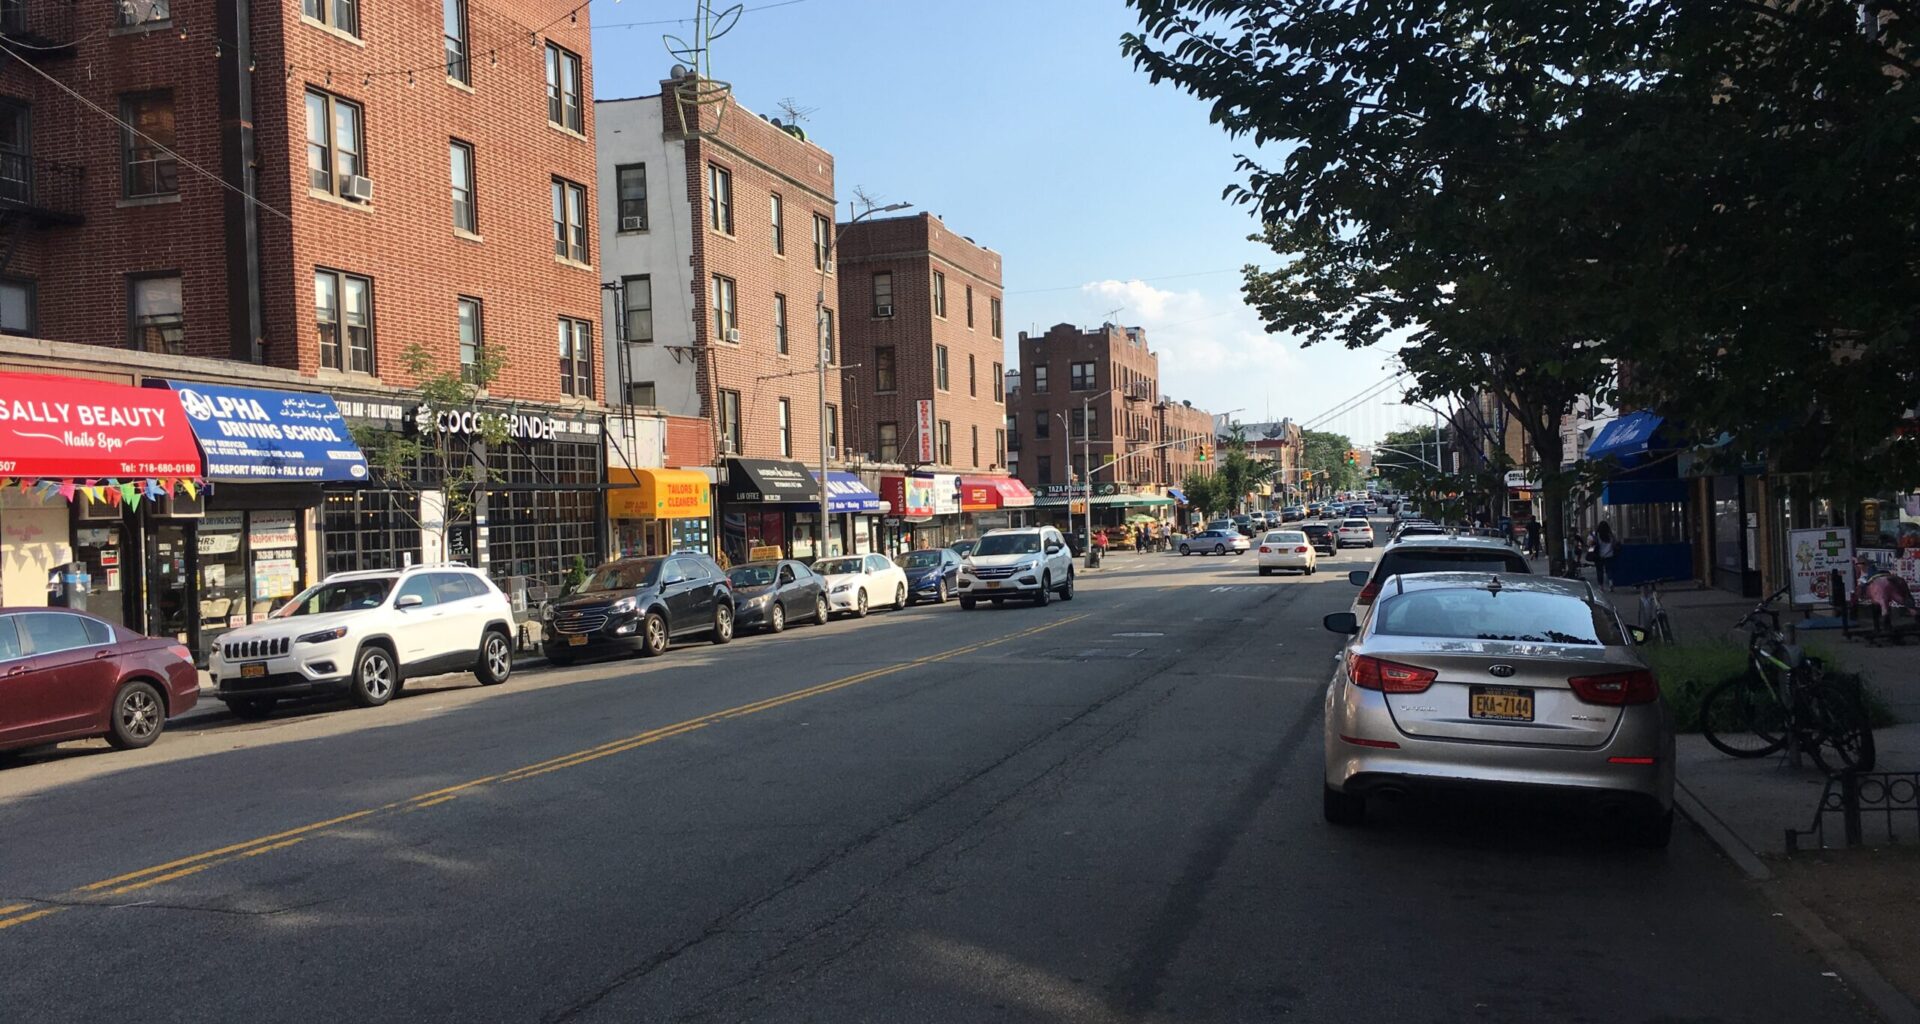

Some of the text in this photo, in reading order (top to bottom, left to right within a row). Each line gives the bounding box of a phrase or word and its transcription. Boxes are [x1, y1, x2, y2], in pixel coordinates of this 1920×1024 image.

[179, 389, 271, 421] ALPHA
[367, 403, 380, 418] FULL
[0, 399, 166, 428] SALLY BEAUTY
[437, 409, 497, 436] COCO
[217, 420, 342, 443] DRIVING SCHOOL
[64, 431, 123, 453] Nails Spa
[121, 462, 137, 473] Tel:
[139, 463, 196, 473] 718-680-0180
[210, 464, 324, 477] PASSPORT PHOTO FAX & COPY
[667, 484, 693, 495] TAILORS
[746, 491, 760, 500] OFFICE
[668, 497, 698, 508] CLEANERS
[1493, 666, 1512, 675] KIA
